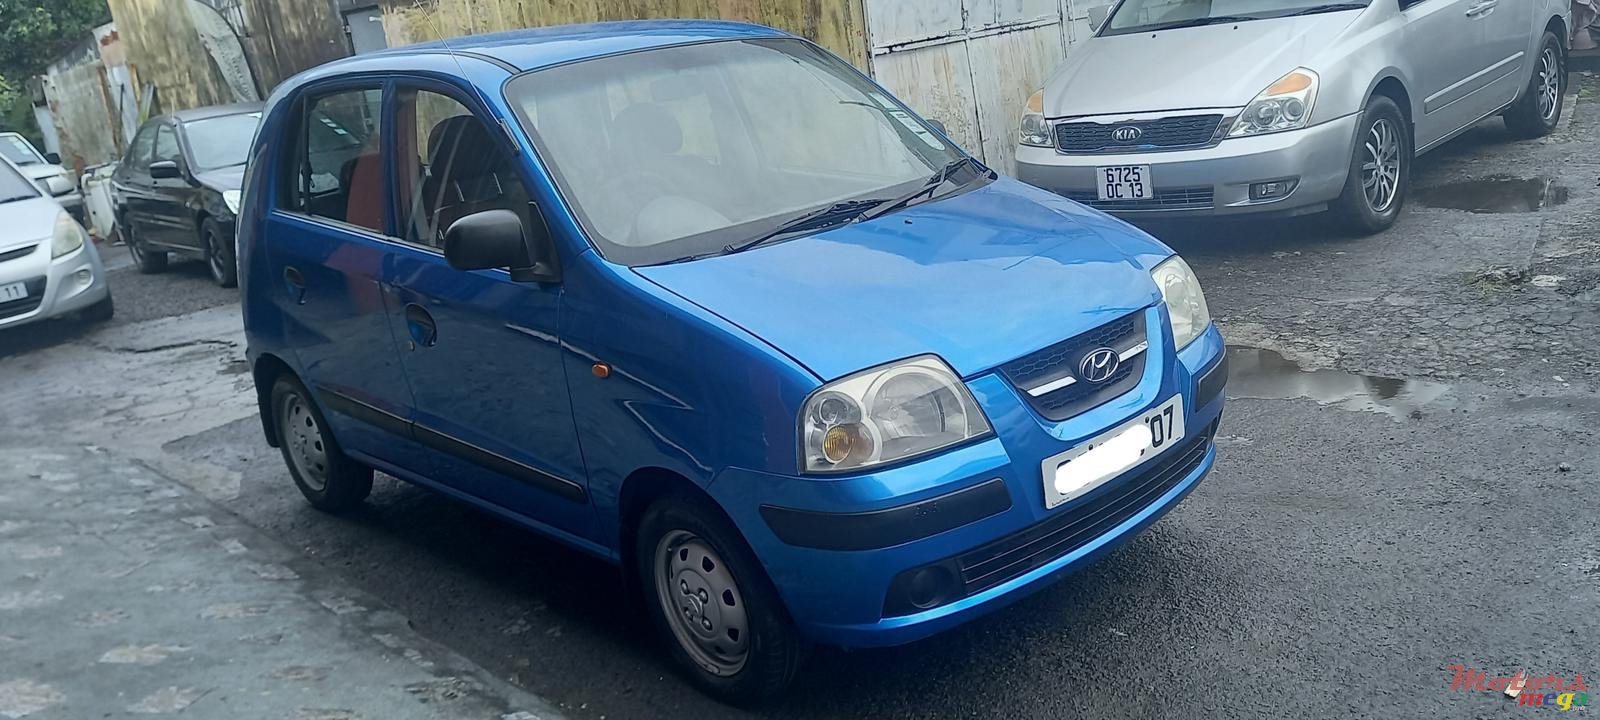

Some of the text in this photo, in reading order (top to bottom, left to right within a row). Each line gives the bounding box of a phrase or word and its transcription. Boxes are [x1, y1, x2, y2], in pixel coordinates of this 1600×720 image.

[1116, 129, 1136, 140] KIA
[1106, 167, 1141, 183] 6725
[1129, 182, 1143, 198] 13
[1150, 404, 1174, 448] 07
